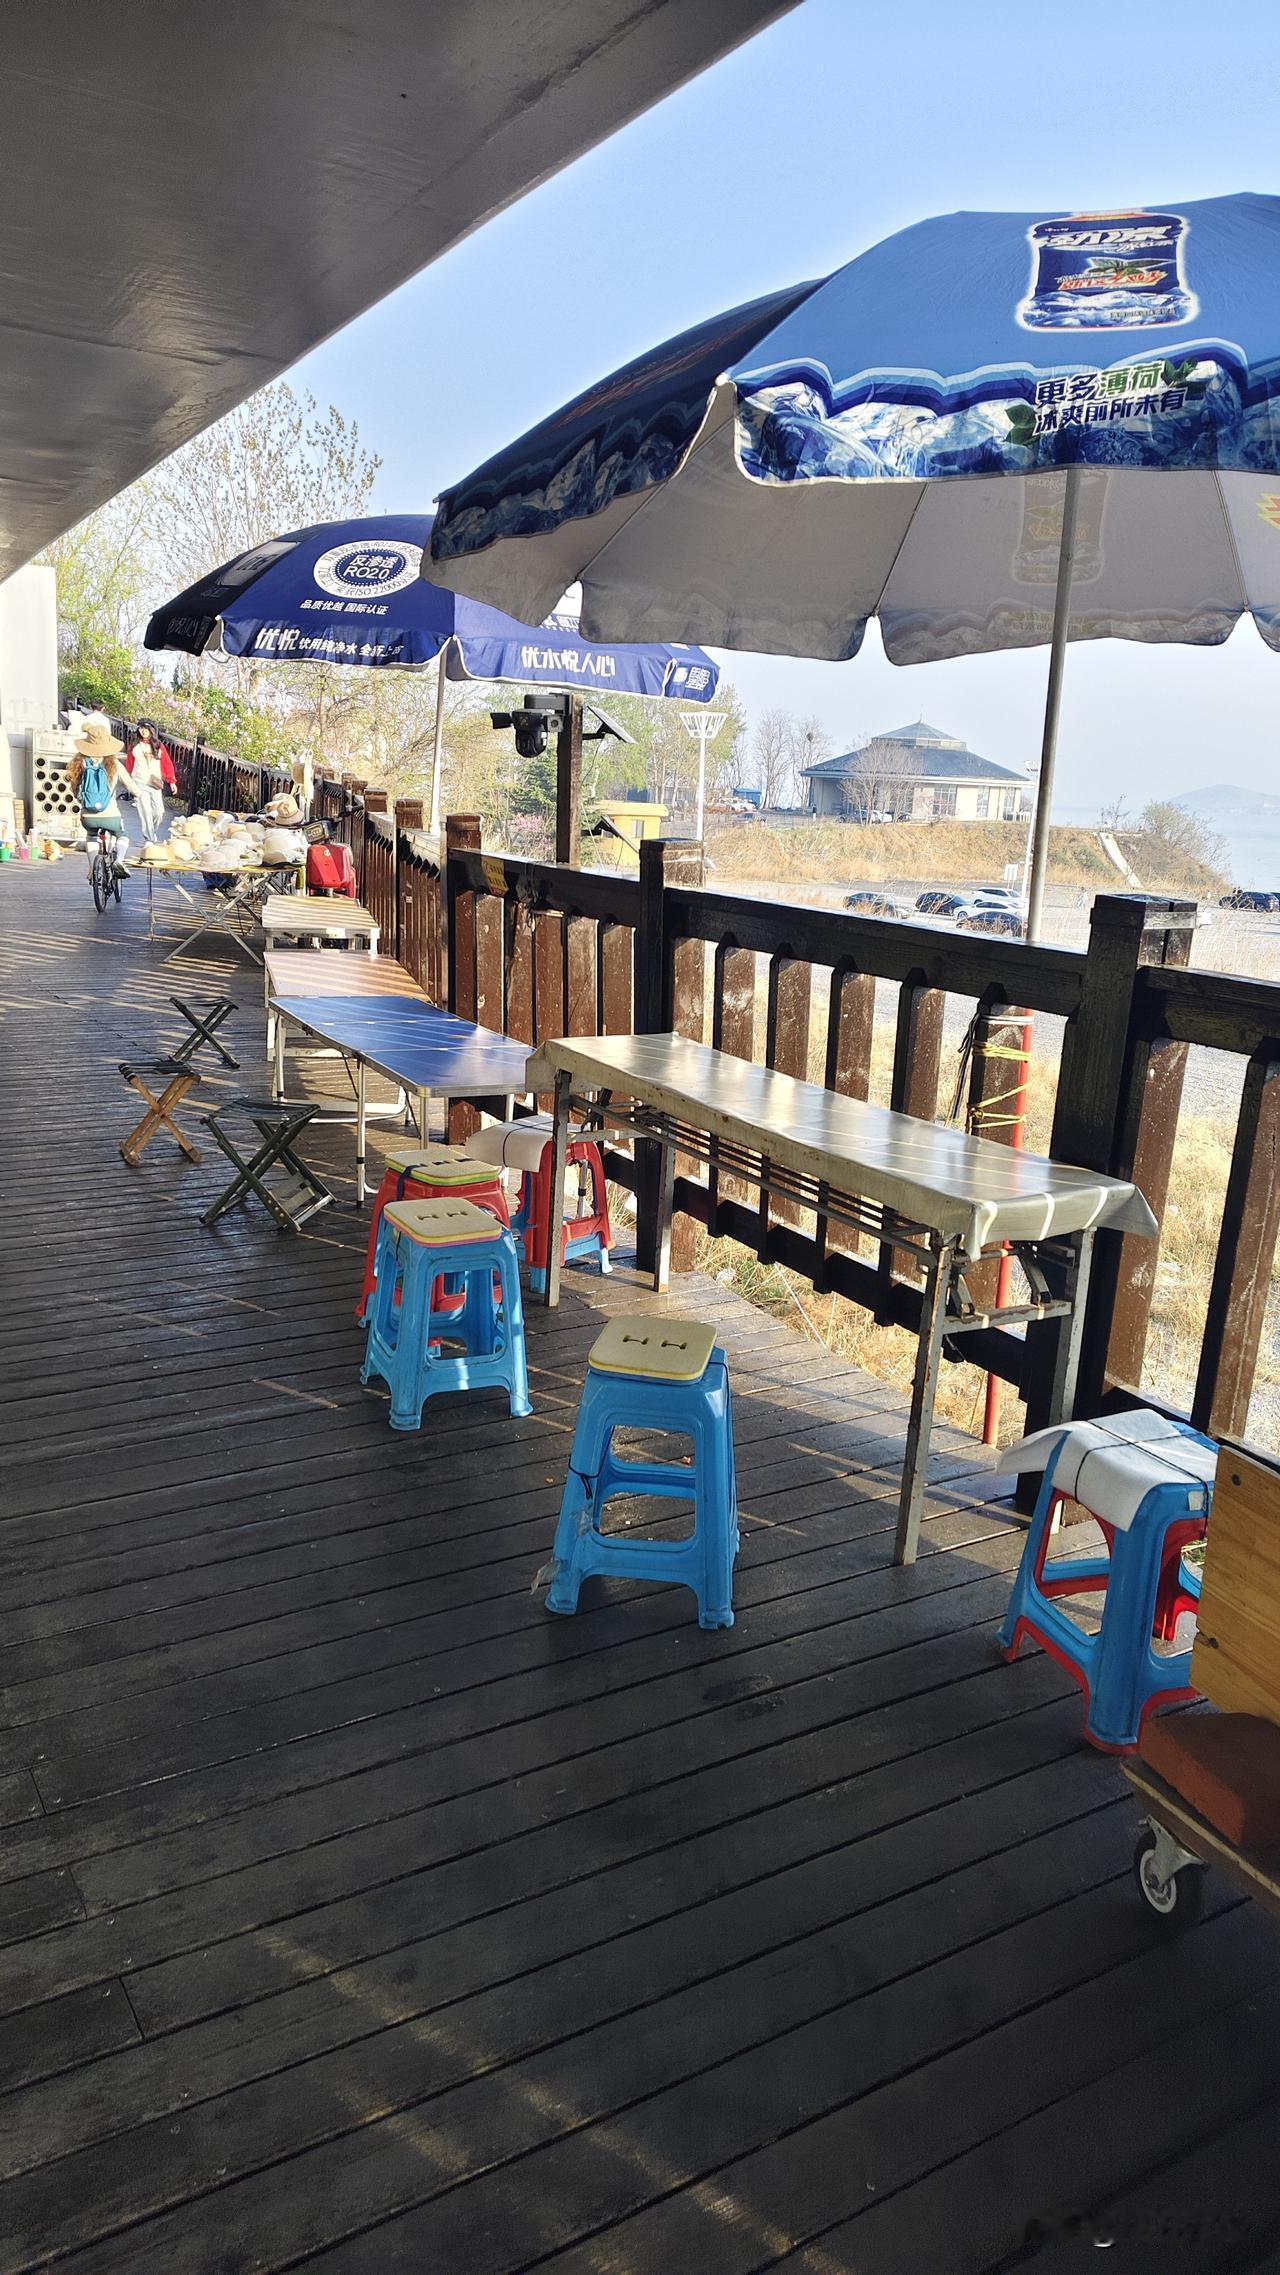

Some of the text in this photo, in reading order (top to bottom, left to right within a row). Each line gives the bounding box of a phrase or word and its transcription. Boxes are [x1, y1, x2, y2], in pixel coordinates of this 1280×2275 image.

[1036, 361, 1165, 408] 更多薄荷
[1033, 388, 1187, 435] 冰爽前所未有
[349, 554, 399, 569] 反渗透
[343, 566, 390, 580] RO20
[300, 599, 389, 615] 品质优越 国际认证
[299, 637, 358, 655] 饮用纯净水
